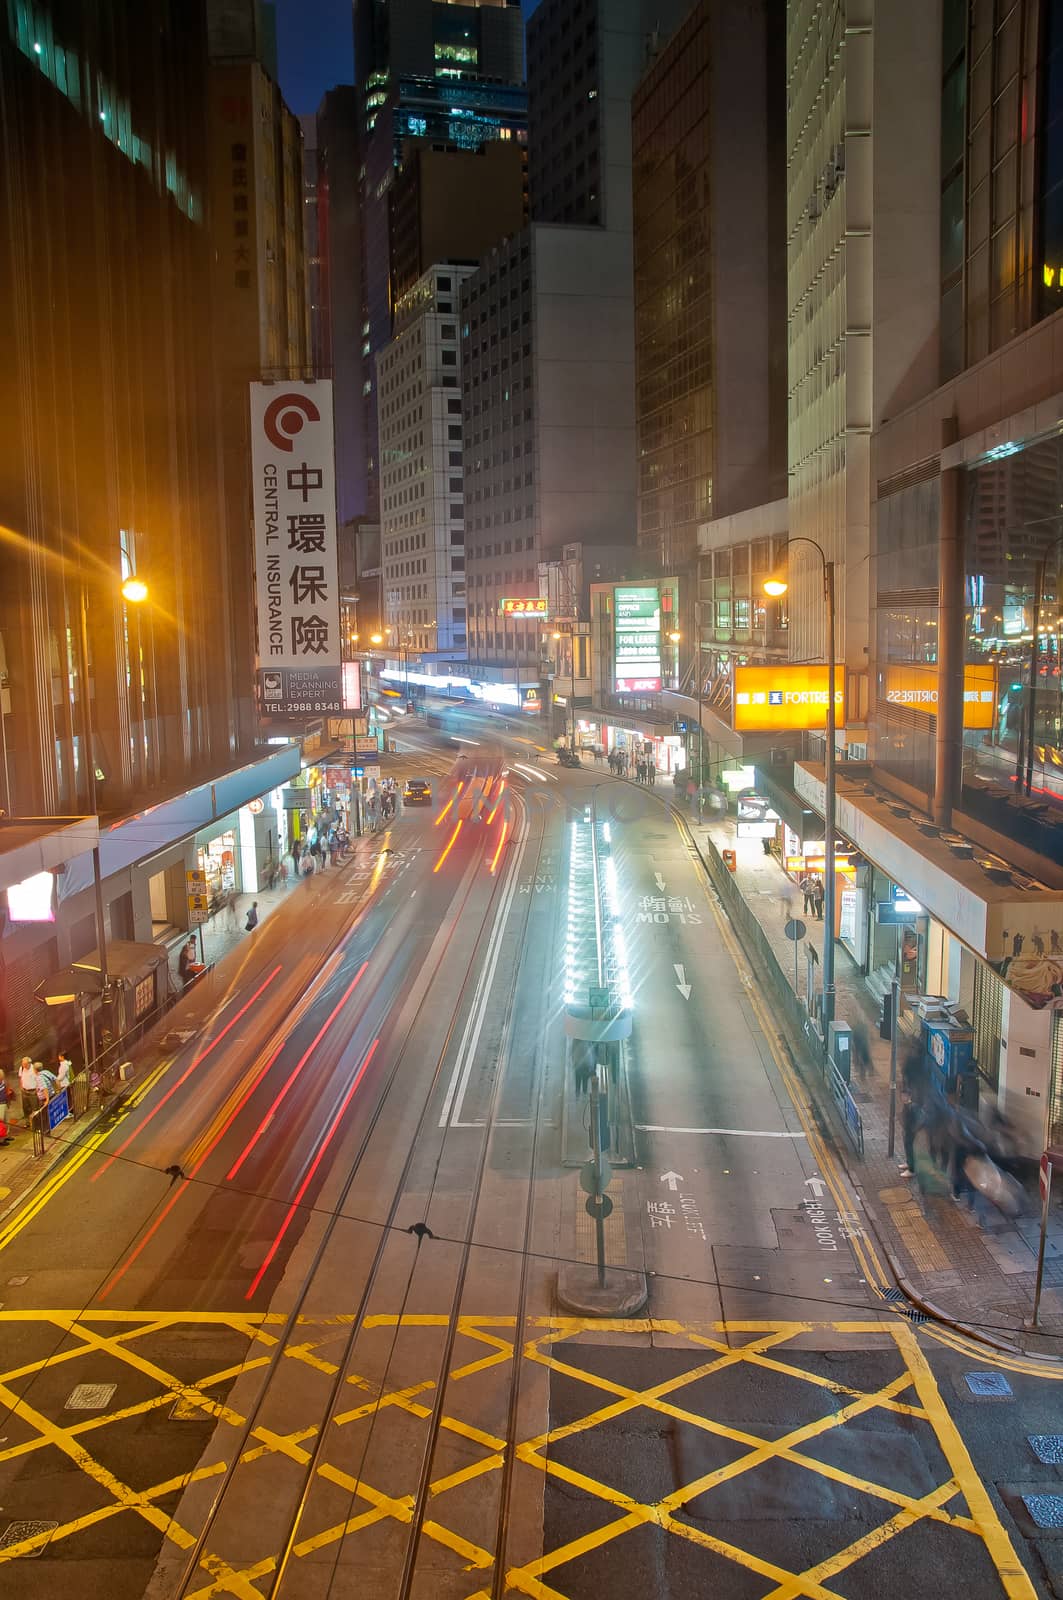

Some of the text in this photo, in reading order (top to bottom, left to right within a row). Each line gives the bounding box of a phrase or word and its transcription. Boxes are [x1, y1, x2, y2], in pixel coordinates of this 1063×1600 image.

[264, 464, 283, 655] CENTRAL INSURANCE
[287, 462, 329, 655] 中環保險
[619, 635, 657, 644] FOR LEASE
[289, 672, 319, 681] MEDIA
[290, 681, 338, 689] PLANNING
[633, 681, 657, 690] KFC
[290, 689, 326, 698] EXPERT
[785, 692, 843, 704] FORTRES
[314, 702, 340, 711] 8348
[635, 912, 703, 925] SLOW
[679, 1193, 699, 1215] LOOK
[647, 1200, 677, 1229] 望左
[803, 1198, 837, 1250] LOOK RIGHT
